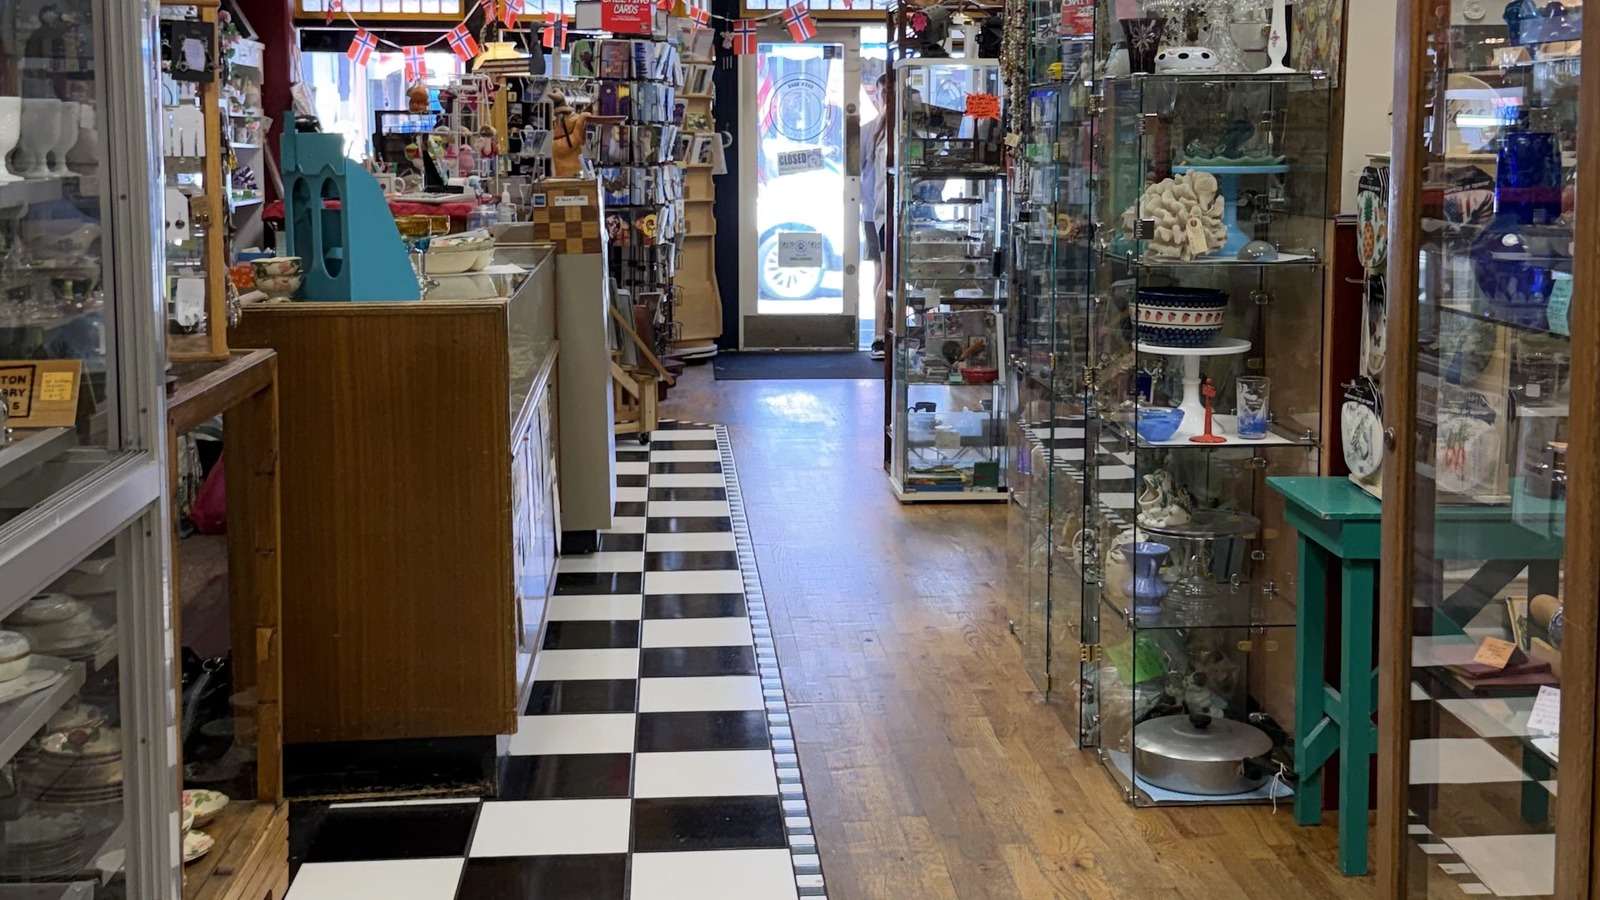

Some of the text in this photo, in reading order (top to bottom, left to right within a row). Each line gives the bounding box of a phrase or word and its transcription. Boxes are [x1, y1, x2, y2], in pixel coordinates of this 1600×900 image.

[613, 4, 639, 14] CARDS
[779, 153, 807, 166] CLOSED
[0, 375, 27, 384] TON
